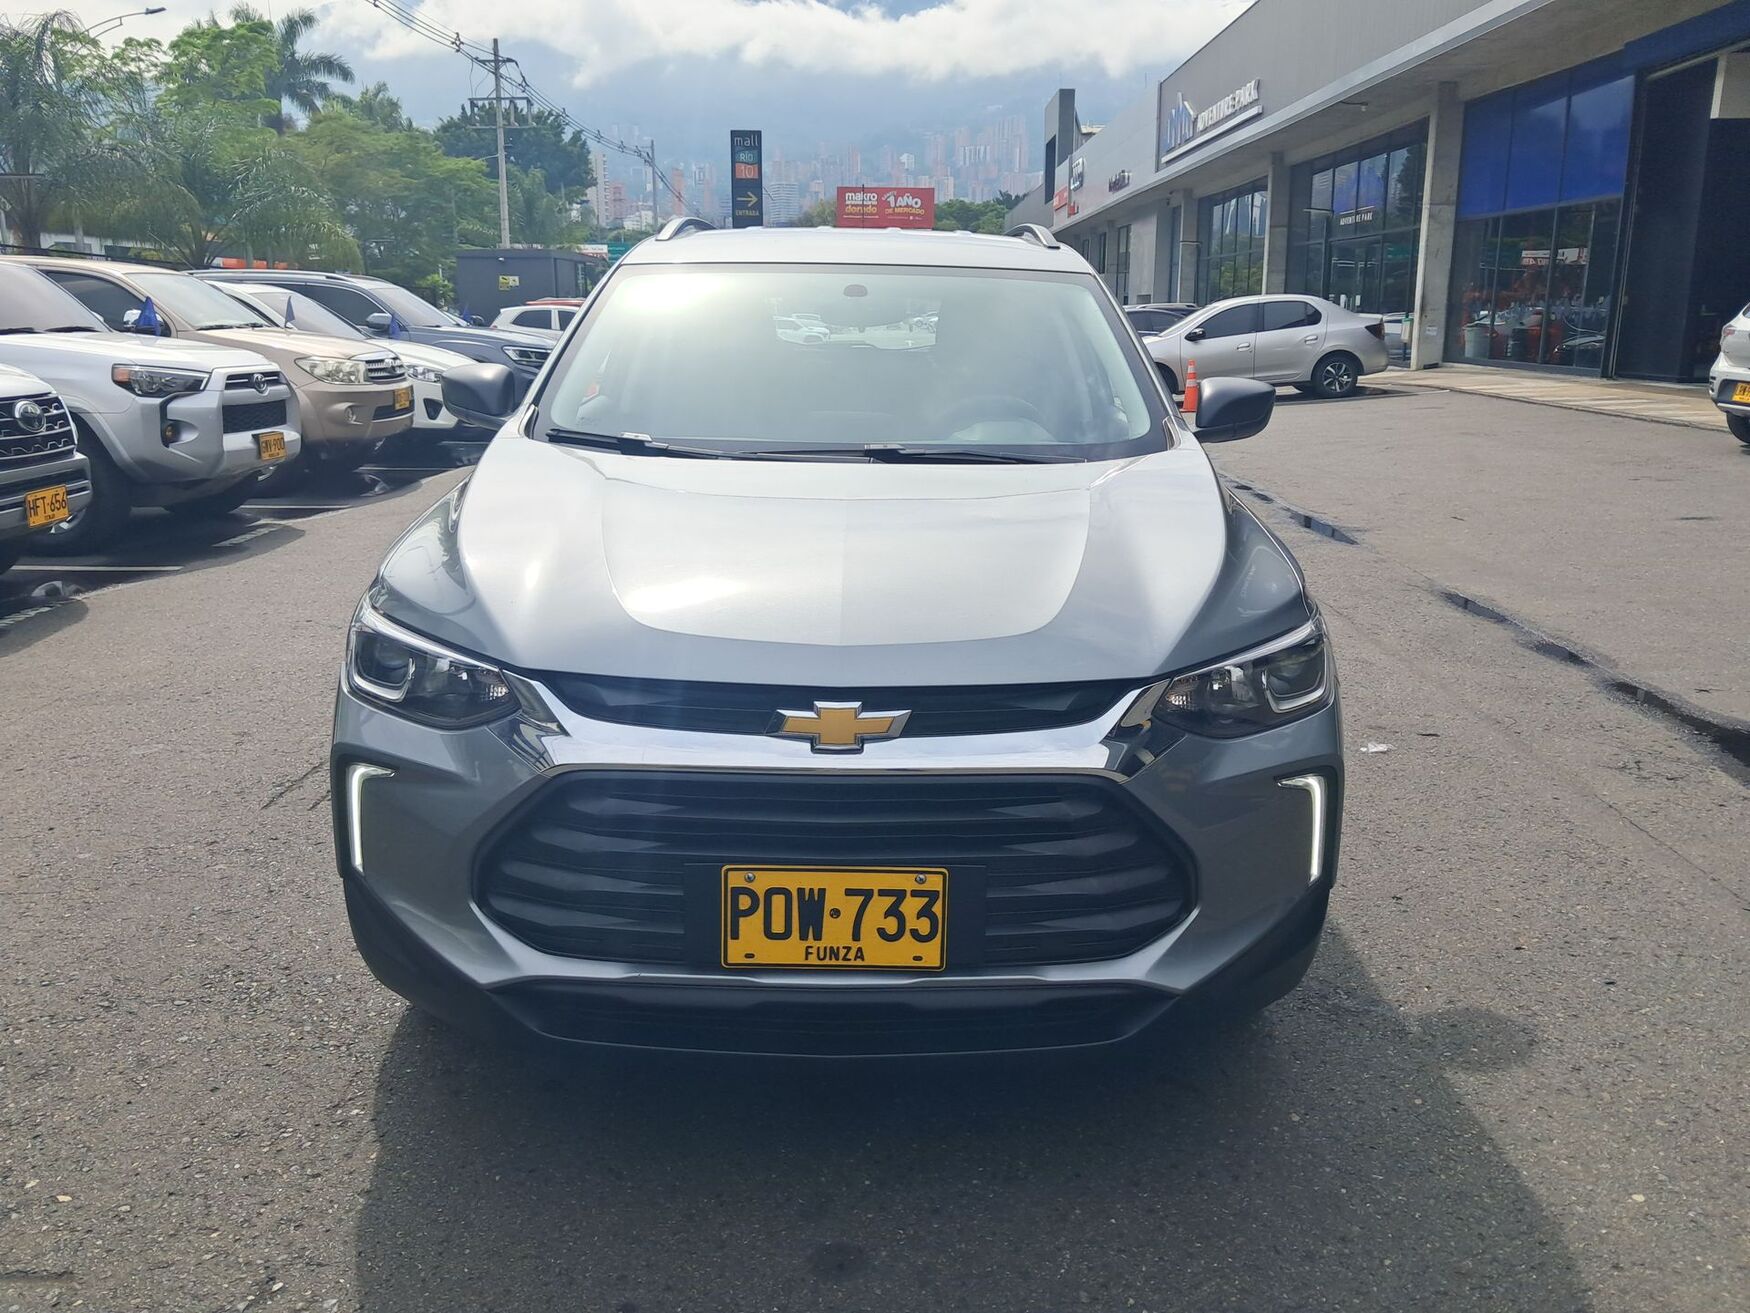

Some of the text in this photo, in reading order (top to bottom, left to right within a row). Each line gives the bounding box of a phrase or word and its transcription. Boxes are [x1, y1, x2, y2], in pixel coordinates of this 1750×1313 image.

[1235, 79, 1260, 108] PARK
[735, 135, 758, 146] mall
[741, 166, 754, 178] 10
[845, 191, 878, 201] makro
[886, 195, 895, 208] 1
[896, 193, 921, 208] AÑO
[894, 207, 925, 215] MERCADO
[804, 945, 865, 962] FUNZA
